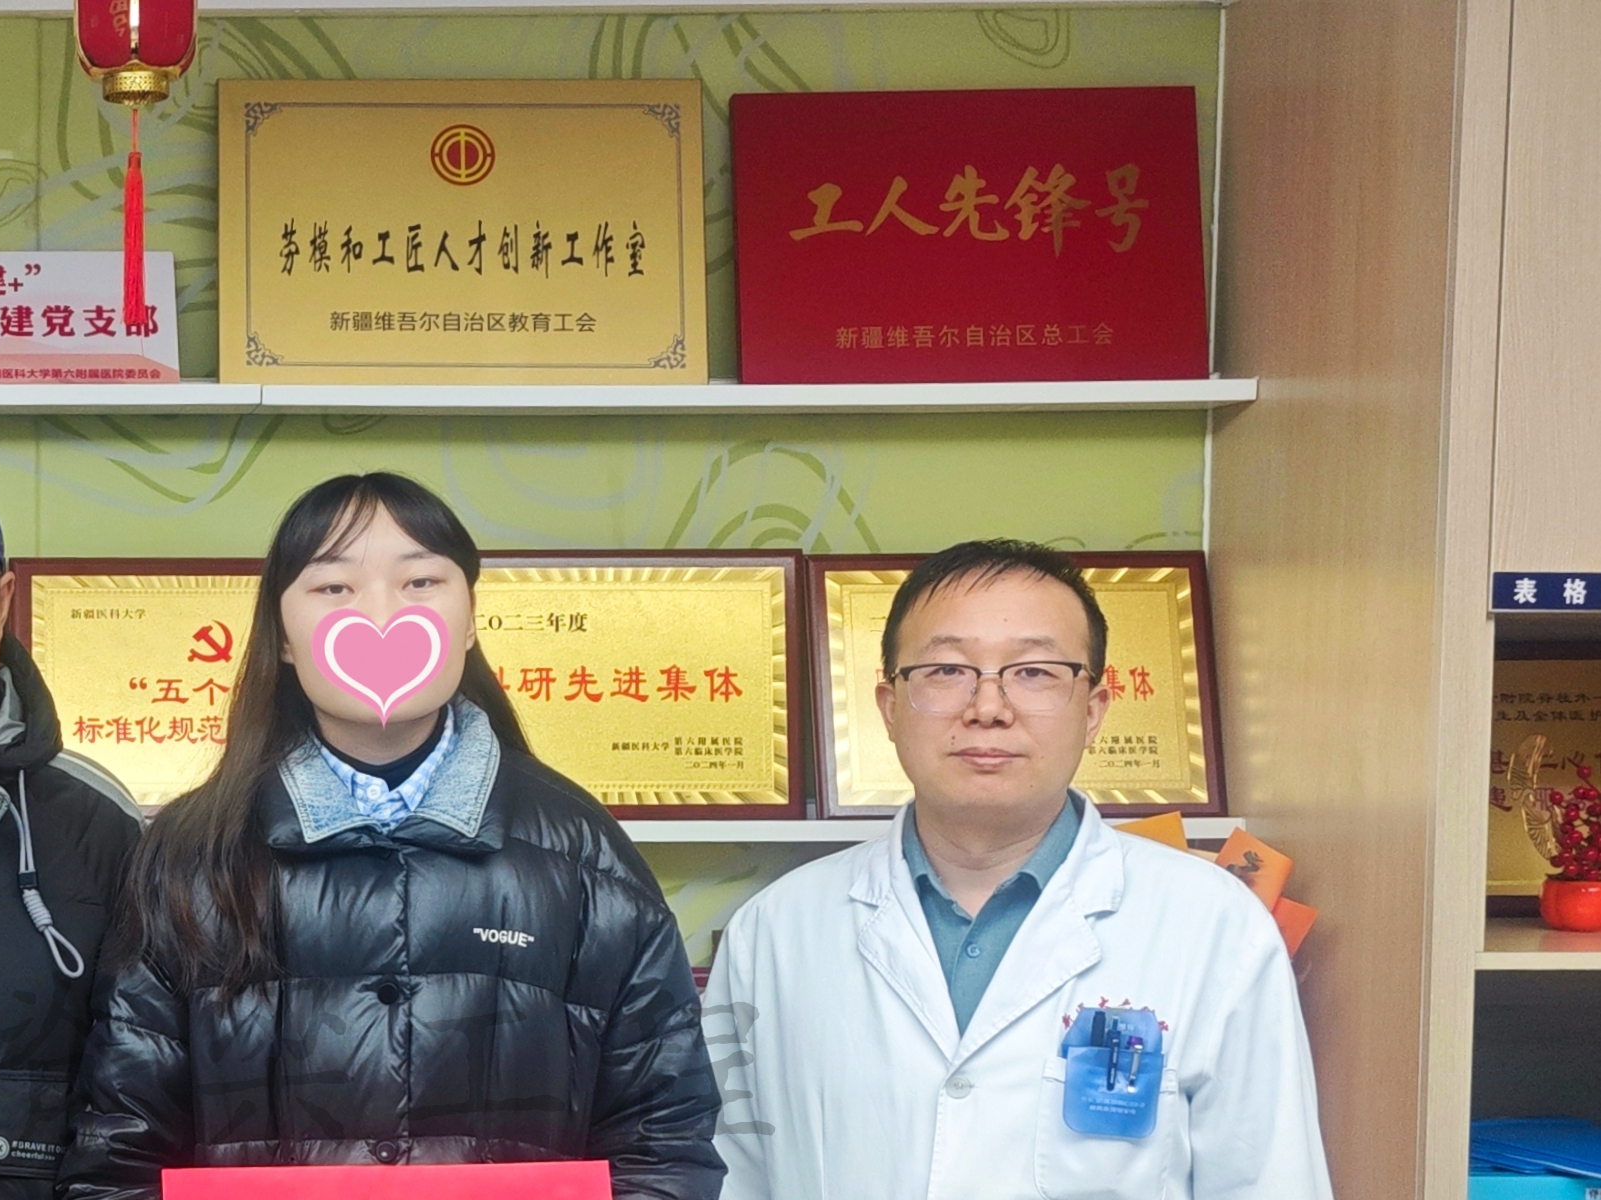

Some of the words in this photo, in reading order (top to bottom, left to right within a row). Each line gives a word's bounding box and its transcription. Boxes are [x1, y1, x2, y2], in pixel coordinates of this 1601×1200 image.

[789, 163, 1150, 258] 工人先锋号
[278, 217, 646, 280] 劳模和工匠人才创新工作室
[329, 311, 597, 333] 新疆维吾尔自治区教育工会
[835, 323, 1114, 349] 新疆维吾尔自治区总工会
[1513, 578, 1588, 604] 表格
[70, 608, 146, 620] 新疆医科大学
[73, 715, 228, 745] 标准化规范
[611, 742, 670, 751] 新疆医科大学
